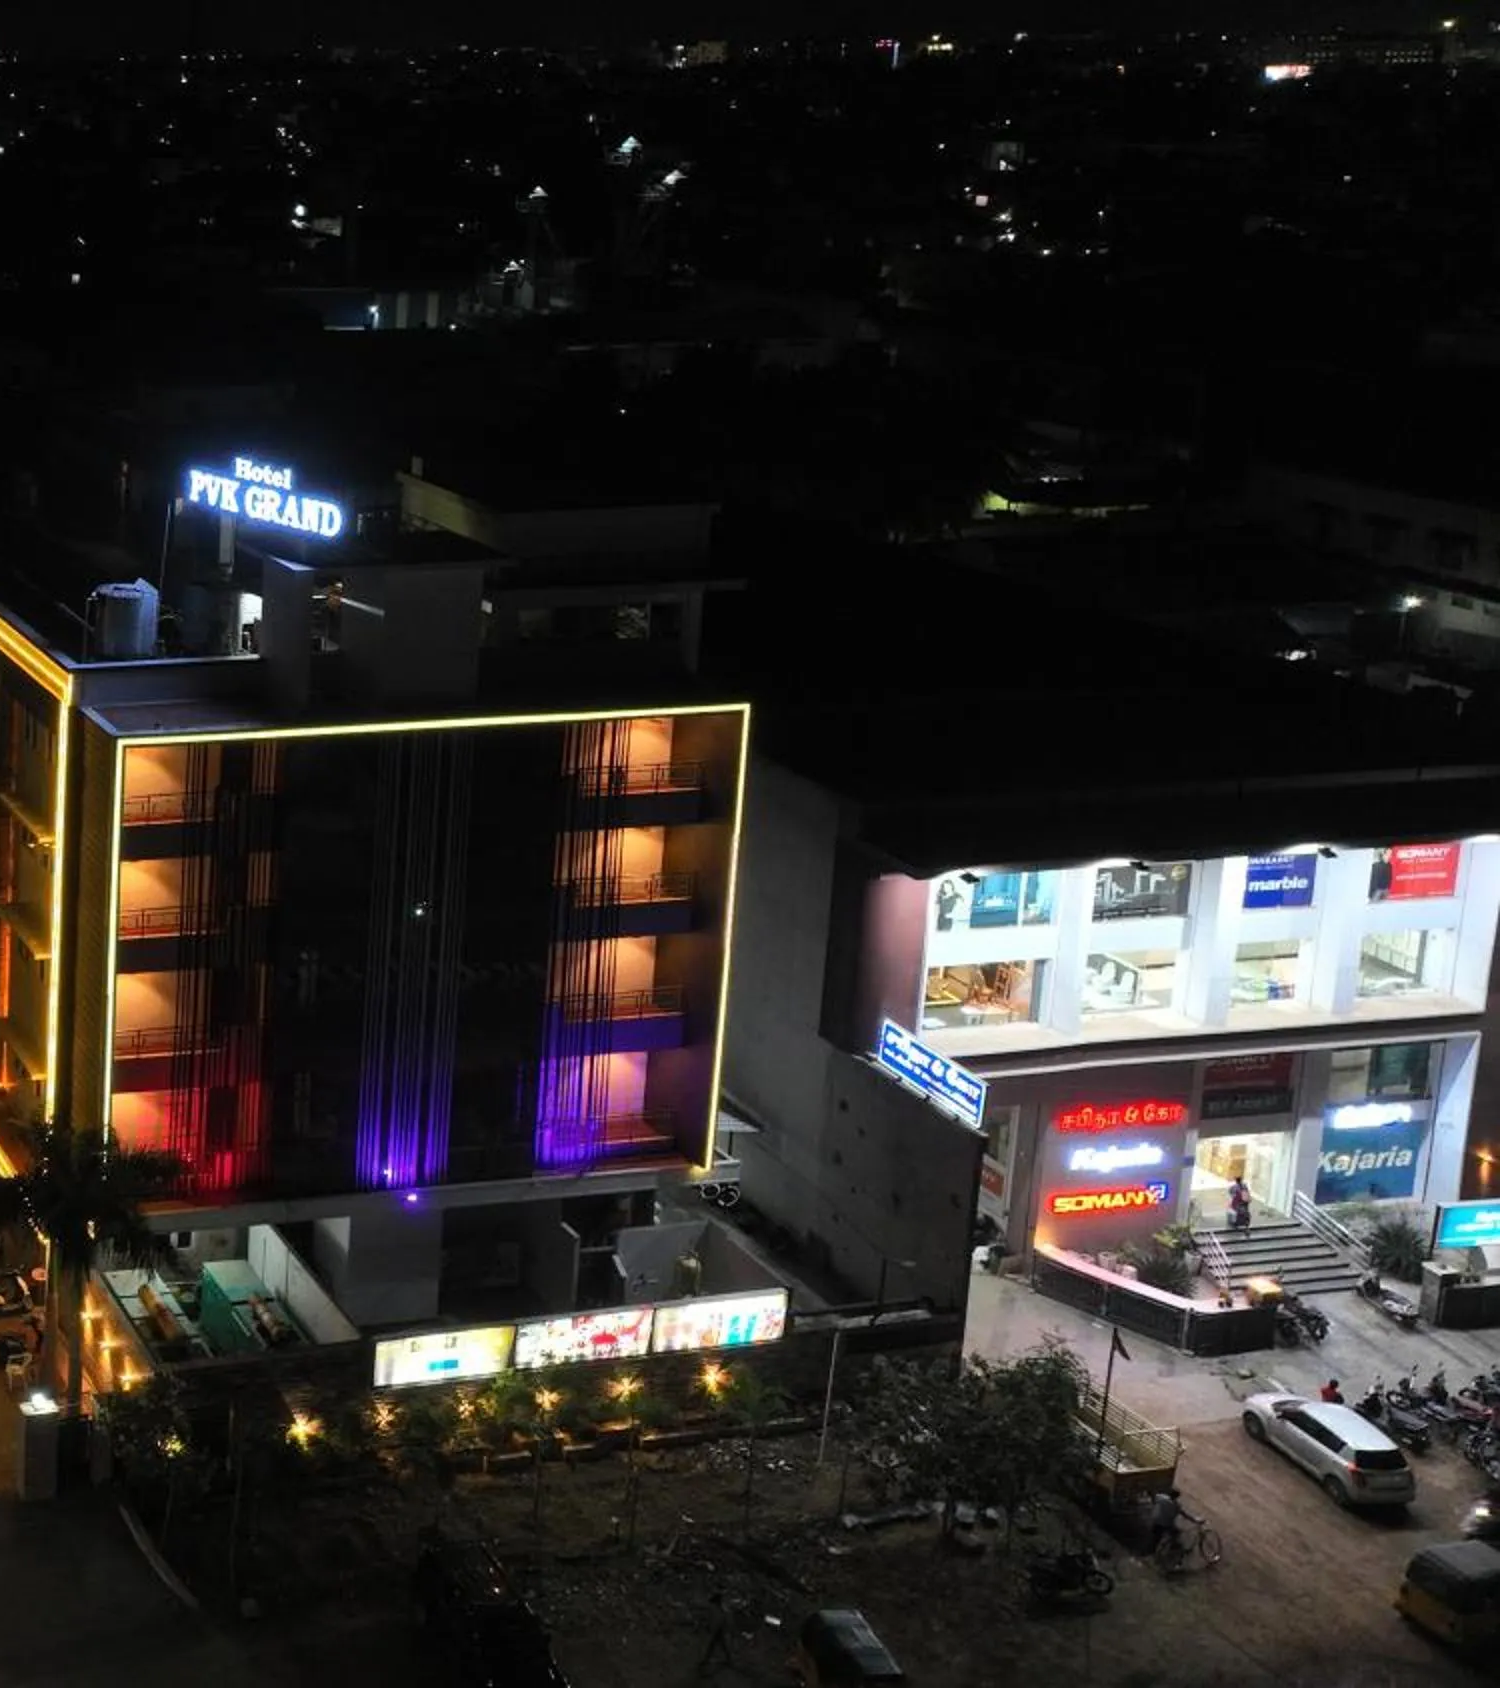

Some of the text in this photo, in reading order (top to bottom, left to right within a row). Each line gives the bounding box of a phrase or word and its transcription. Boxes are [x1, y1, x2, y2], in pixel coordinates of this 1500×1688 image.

[235, 457, 293, 490] Hotel
[189, 469, 342, 537] PVK GRAND
[1317, 1145, 1413, 1177] Kajaria
[1052, 1190, 1160, 1213] SOMANY
